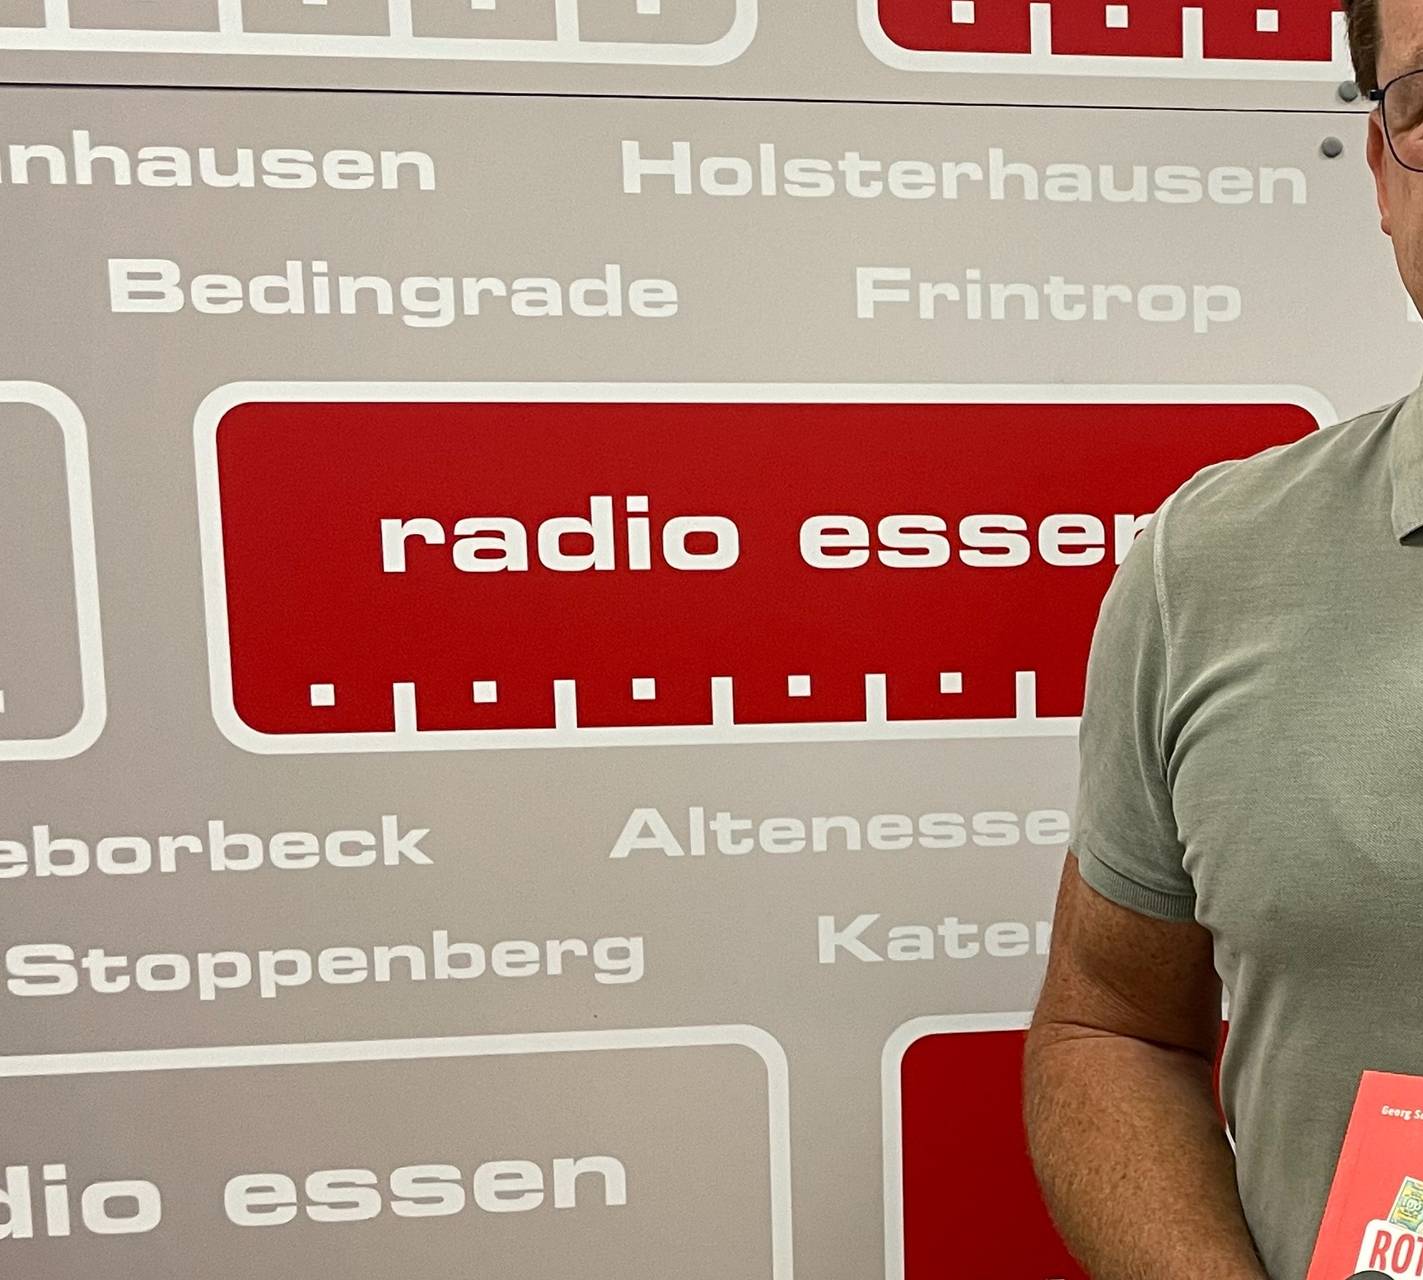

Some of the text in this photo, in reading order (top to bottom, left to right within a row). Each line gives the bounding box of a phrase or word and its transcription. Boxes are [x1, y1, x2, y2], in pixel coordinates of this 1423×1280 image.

[0, 130, 435, 190] nhausen
[621, 141, 1307, 205] Holsterhausen
[108, 259, 679, 327] Bedingrade
[856, 267, 1242, 333] Frintrop
[380, 496, 740, 573] radio
[0, 815, 434, 879] eborbeck
[609, 807, 1070, 858] Altenesse
[5, 930, 645, 1000] Stoppenberg
[1381, 1105, 1412, 1121] Georg
[224, 1155, 627, 1227] essen
